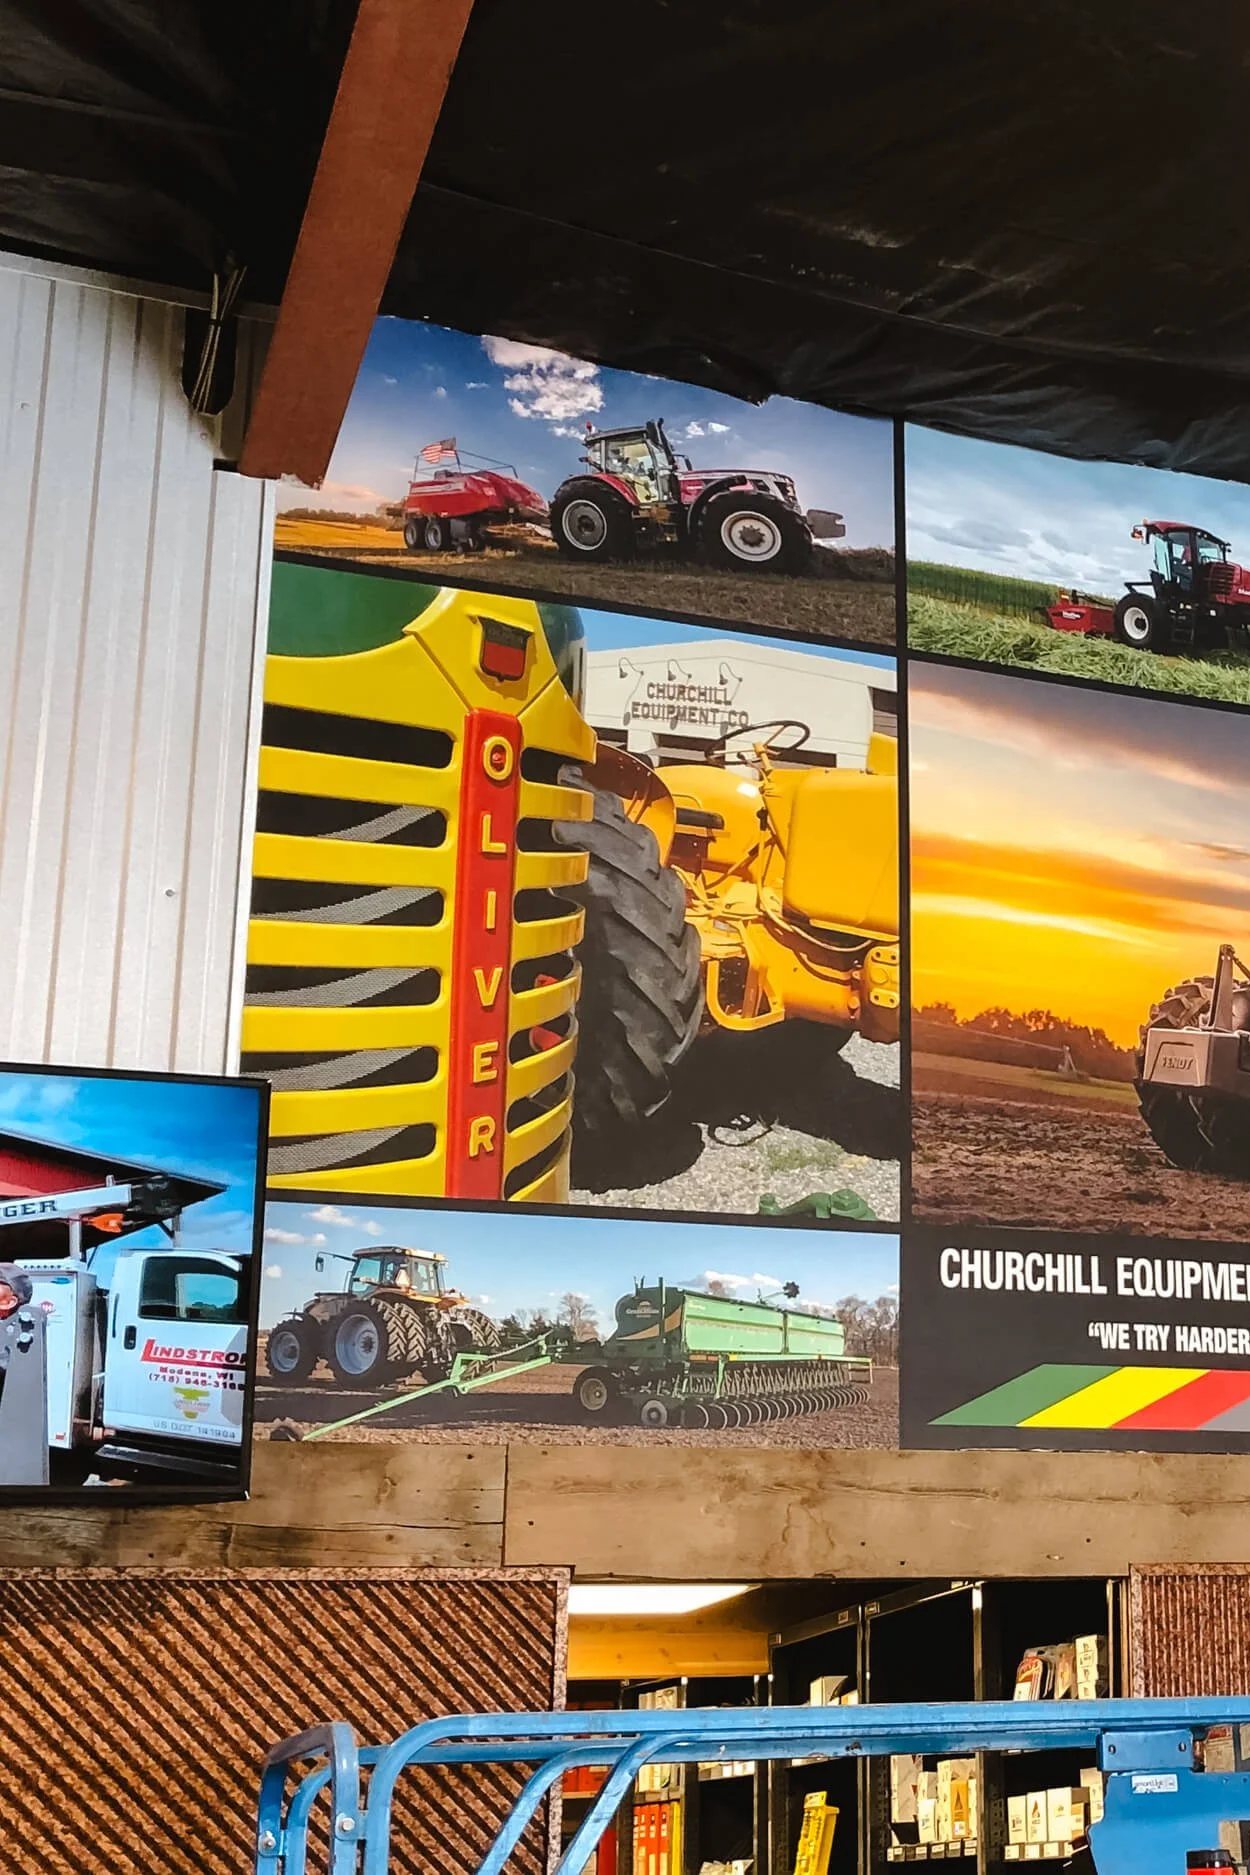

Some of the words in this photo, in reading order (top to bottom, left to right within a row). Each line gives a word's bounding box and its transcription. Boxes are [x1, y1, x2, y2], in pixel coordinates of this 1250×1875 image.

[646, 682, 732, 705] CHURCHILL
[631, 701, 720, 725] EQUIPMENT
[468, 735, 514, 1158] OLIVER
[0, 1200, 57, 1217] GER
[939, 1247, 1108, 1295] CHURCHILL
[1088, 1321, 1131, 1350] “WE
[1133, 1323, 1171, 1351] TRY
[216, 1371, 234, 1381] WI
